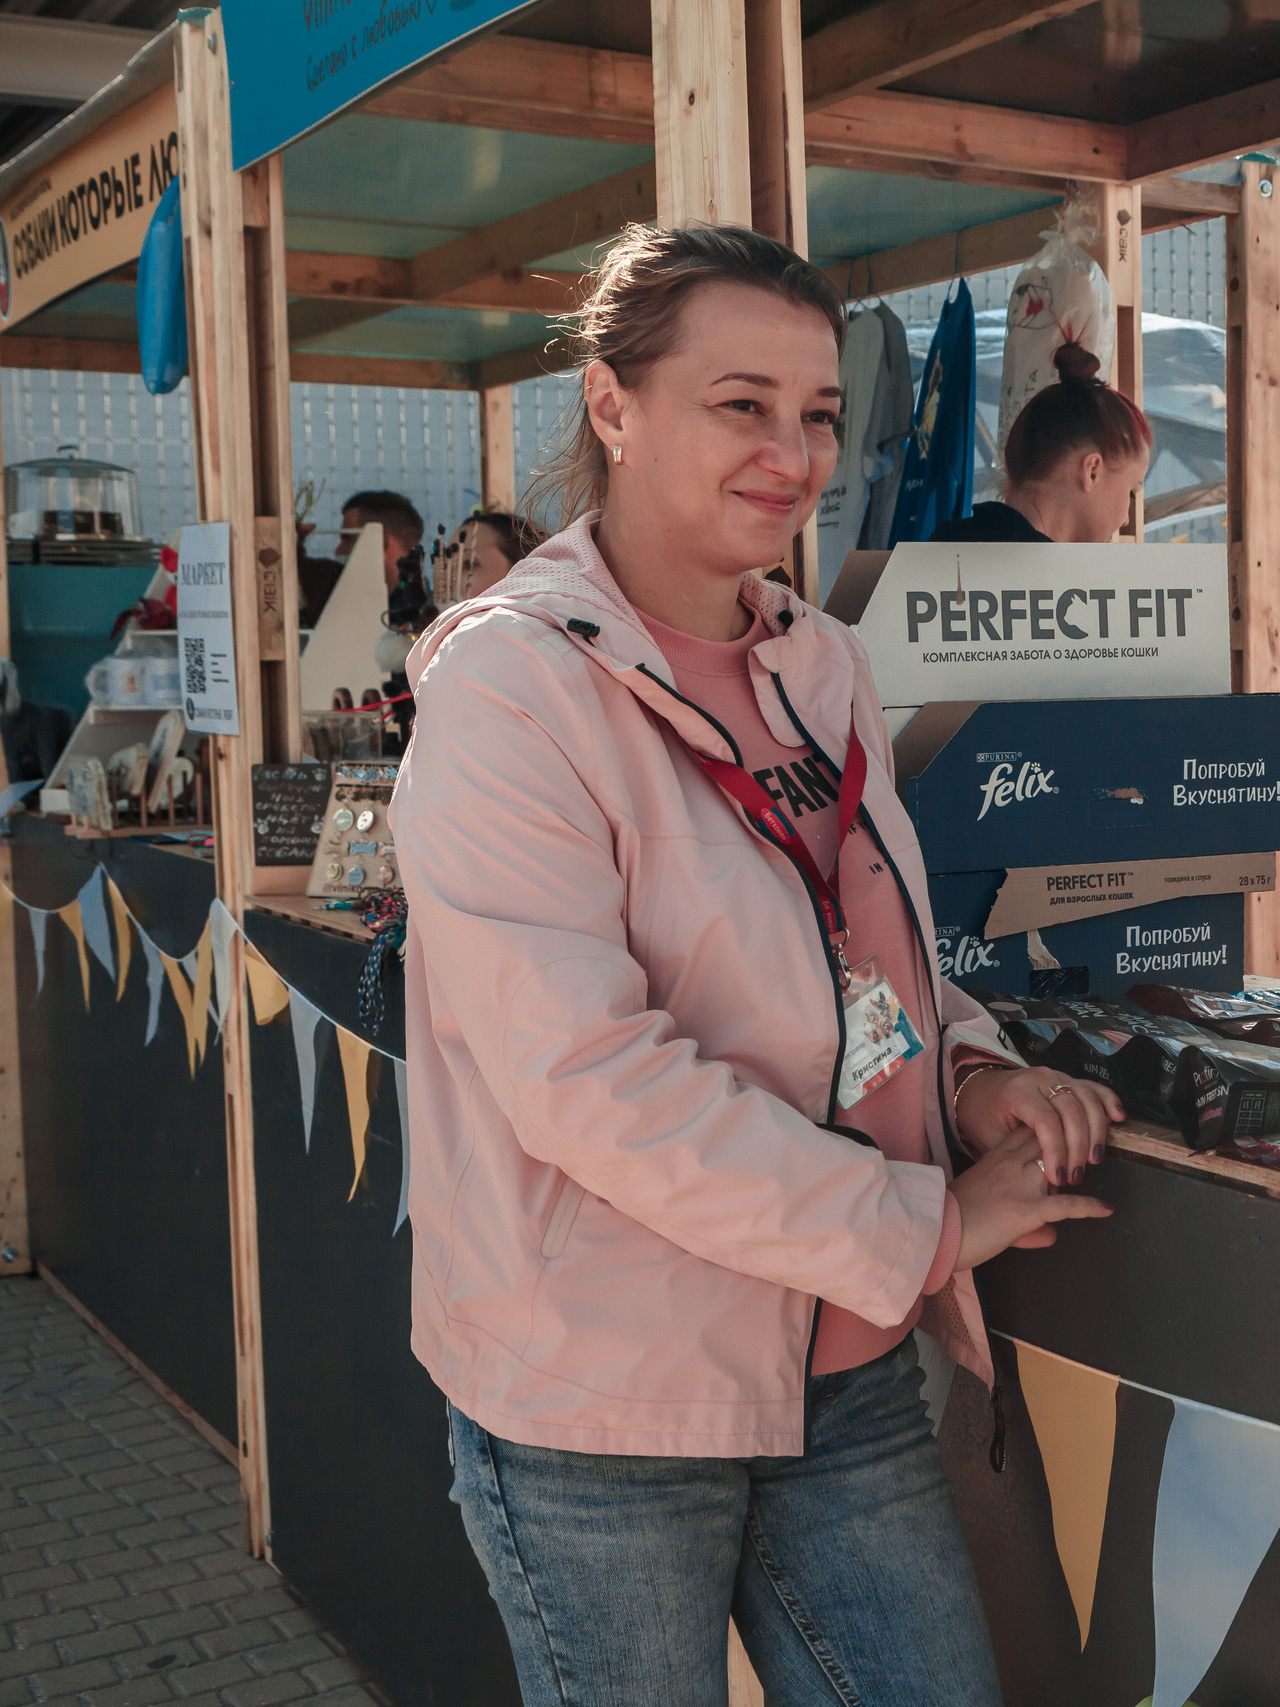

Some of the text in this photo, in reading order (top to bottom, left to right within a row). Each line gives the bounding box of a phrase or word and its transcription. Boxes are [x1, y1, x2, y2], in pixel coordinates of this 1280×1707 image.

[13, 203, 60, 280] СОБАКИ
[56, 152, 143, 248] КОТОРЫЕ
[149, 131, 179, 202] ЛЮ
[181, 561, 226, 586] МАРКЕТ
[906, 588, 1193, 642] PERFECT FIT
[922, 647, 1159, 663] КОМПЛЕКСНАЯ ЗАБОТА О ЗДОРОВЬЕ КОШКИ
[985, 753, 1015, 761] PURINA
[752, 753, 840, 818] FAN
[1046, 872, 1127, 891] PERFECT FIT
[1239, 876, 1249, 886] 28
[1256, 875, 1265, 885] 75
[1050, 892, 1134, 905] ДЛЯ ВЗРОСЛЫХ КОШЕК
[851, 1046, 893, 1082] Кристина
[1192, 1066, 1219, 1088] Profin
